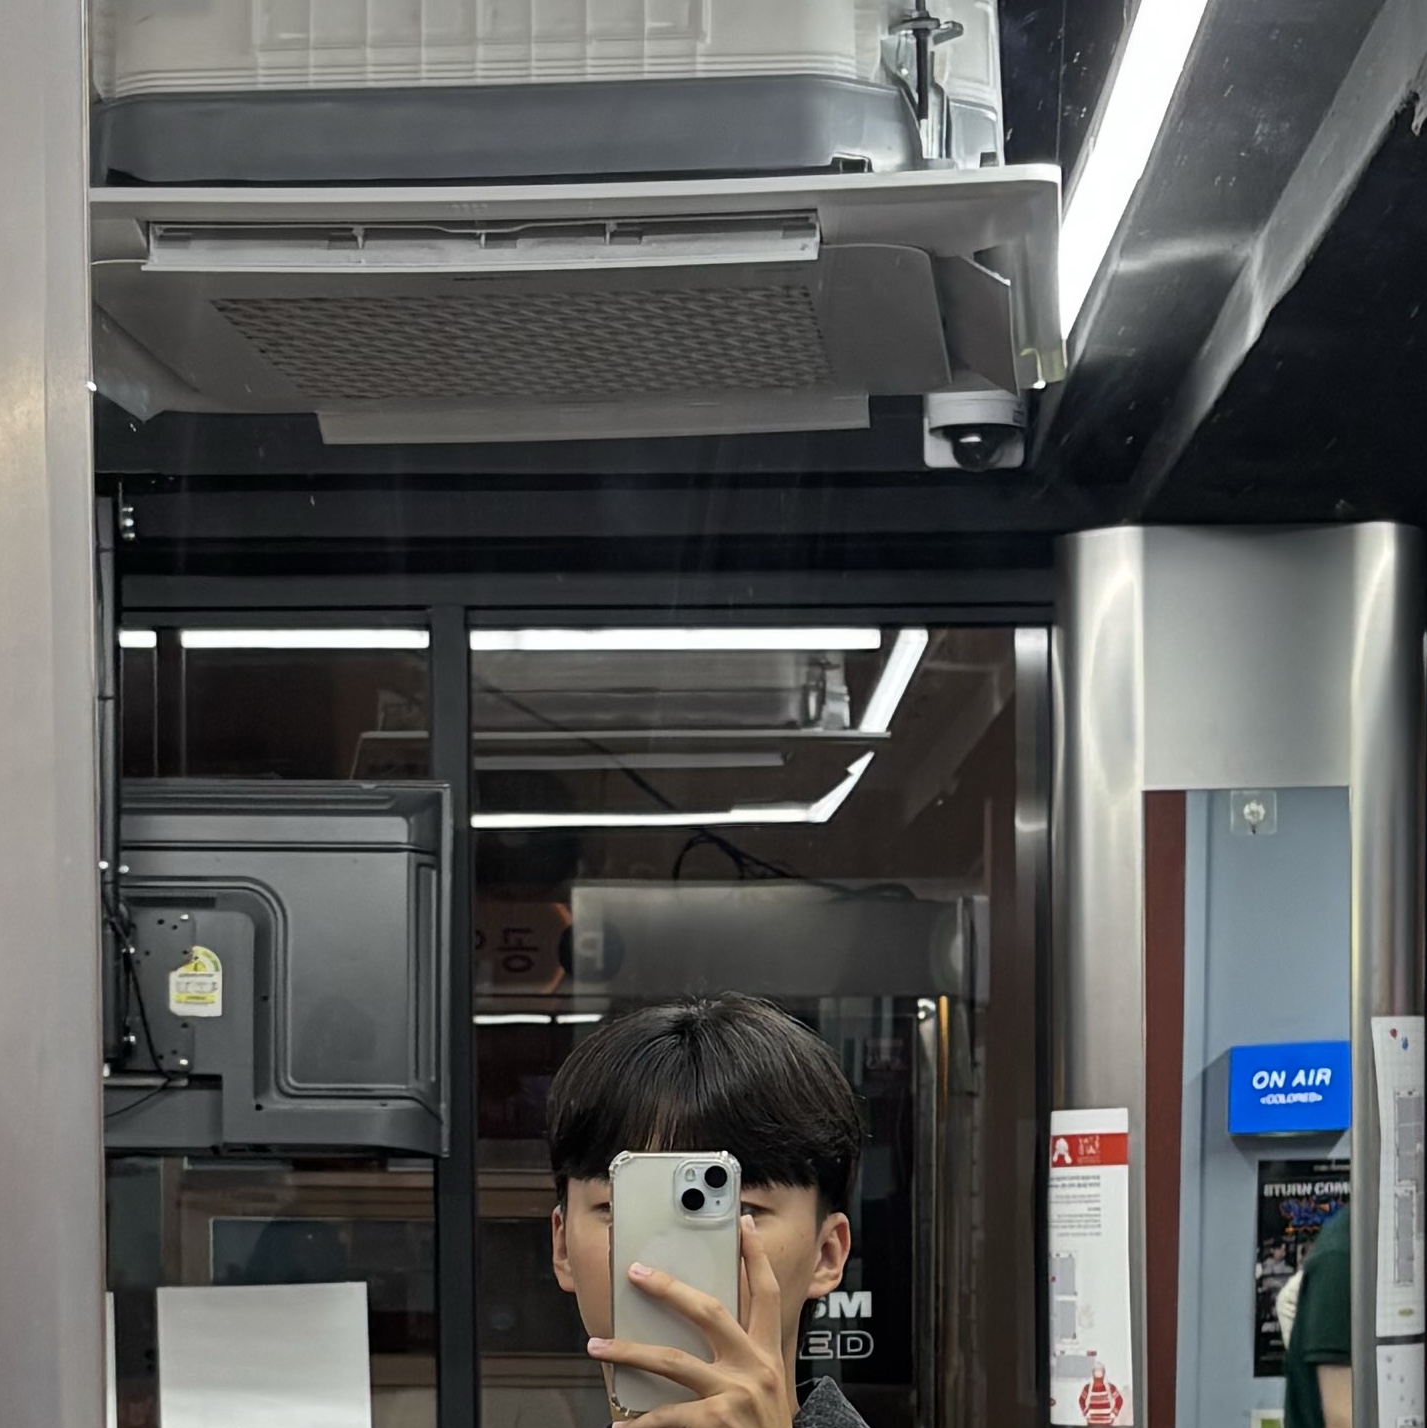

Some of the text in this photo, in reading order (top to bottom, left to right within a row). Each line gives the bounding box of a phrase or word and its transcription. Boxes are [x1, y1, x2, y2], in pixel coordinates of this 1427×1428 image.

[1252, 1067, 1331, 1089] ON AIR
[1313, 1181, 1351, 1195] COM
